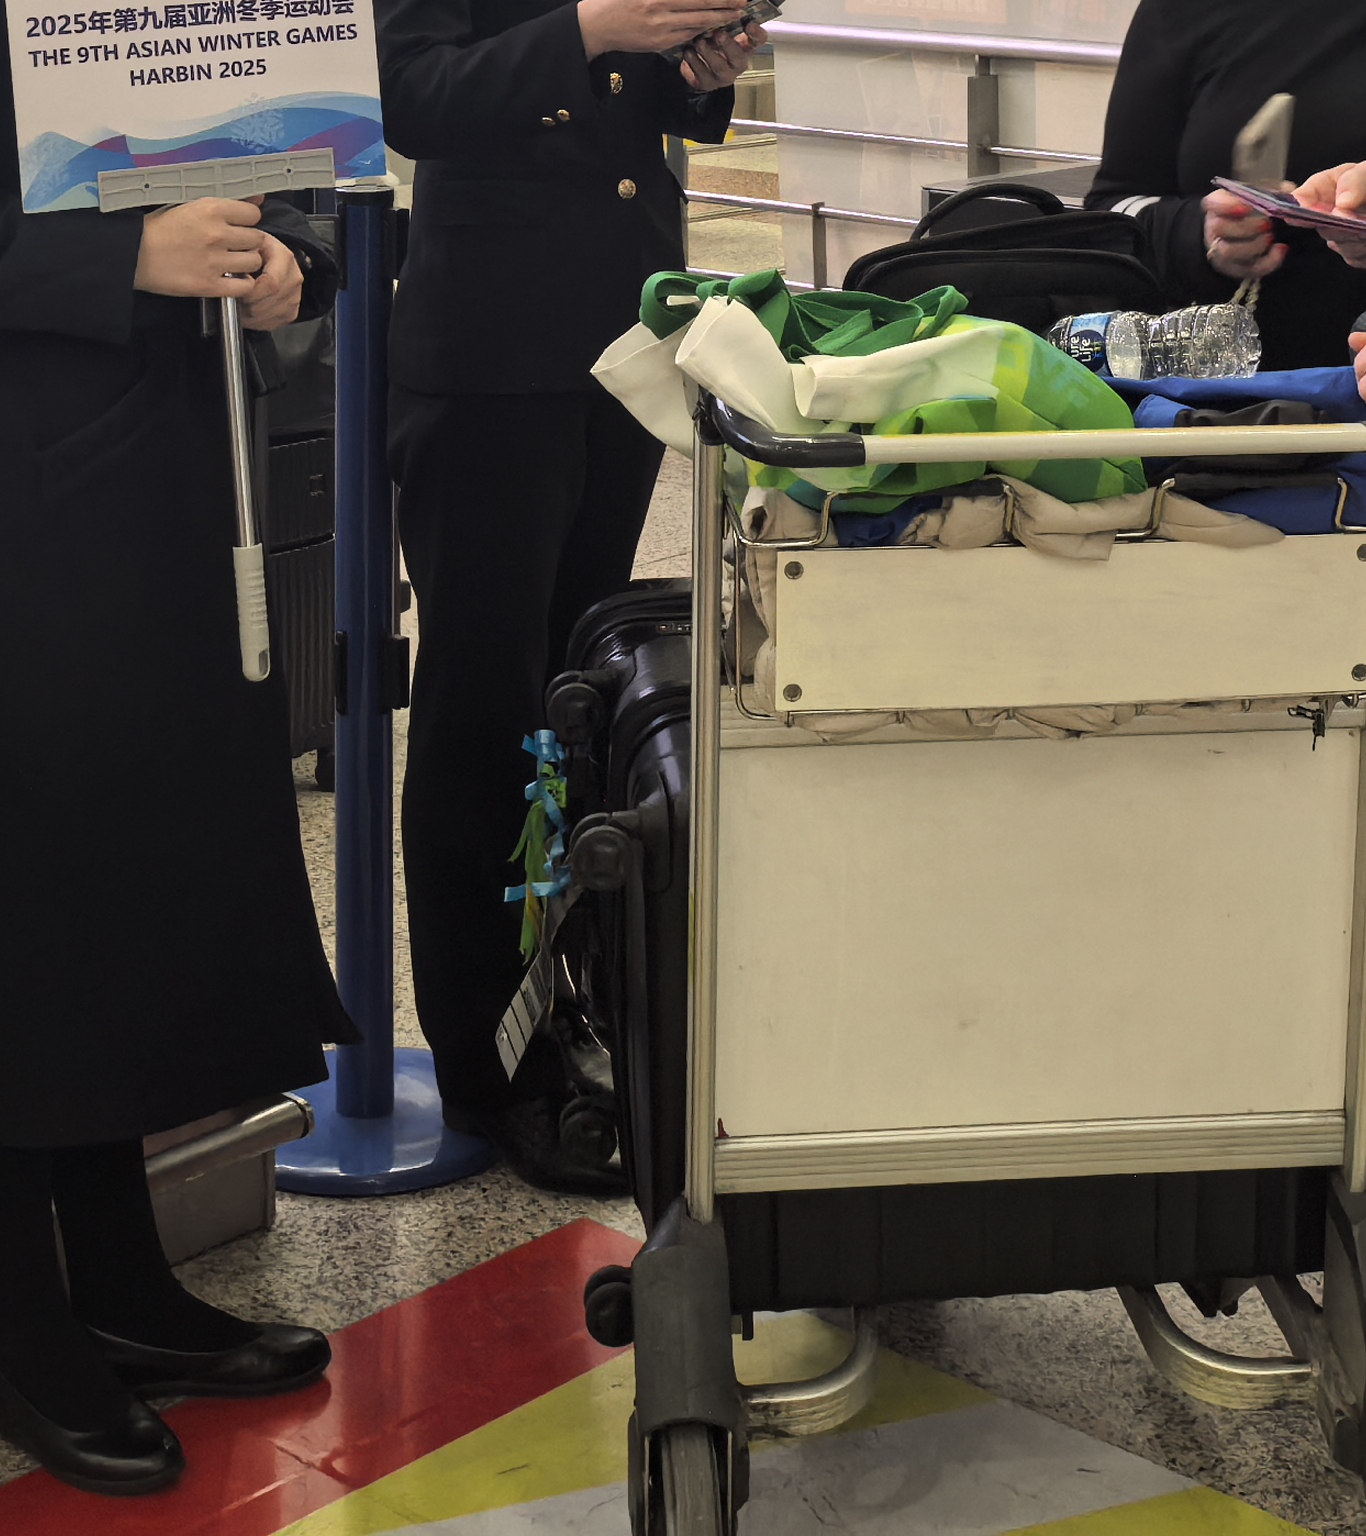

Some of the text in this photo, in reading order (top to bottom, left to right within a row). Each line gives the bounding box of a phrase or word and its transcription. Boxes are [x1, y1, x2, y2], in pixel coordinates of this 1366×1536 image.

[28, 23, 359, 68] THE 9TH ASIAN WINTER GAMES
[129, 58, 268, 87] HARBIN 2025
